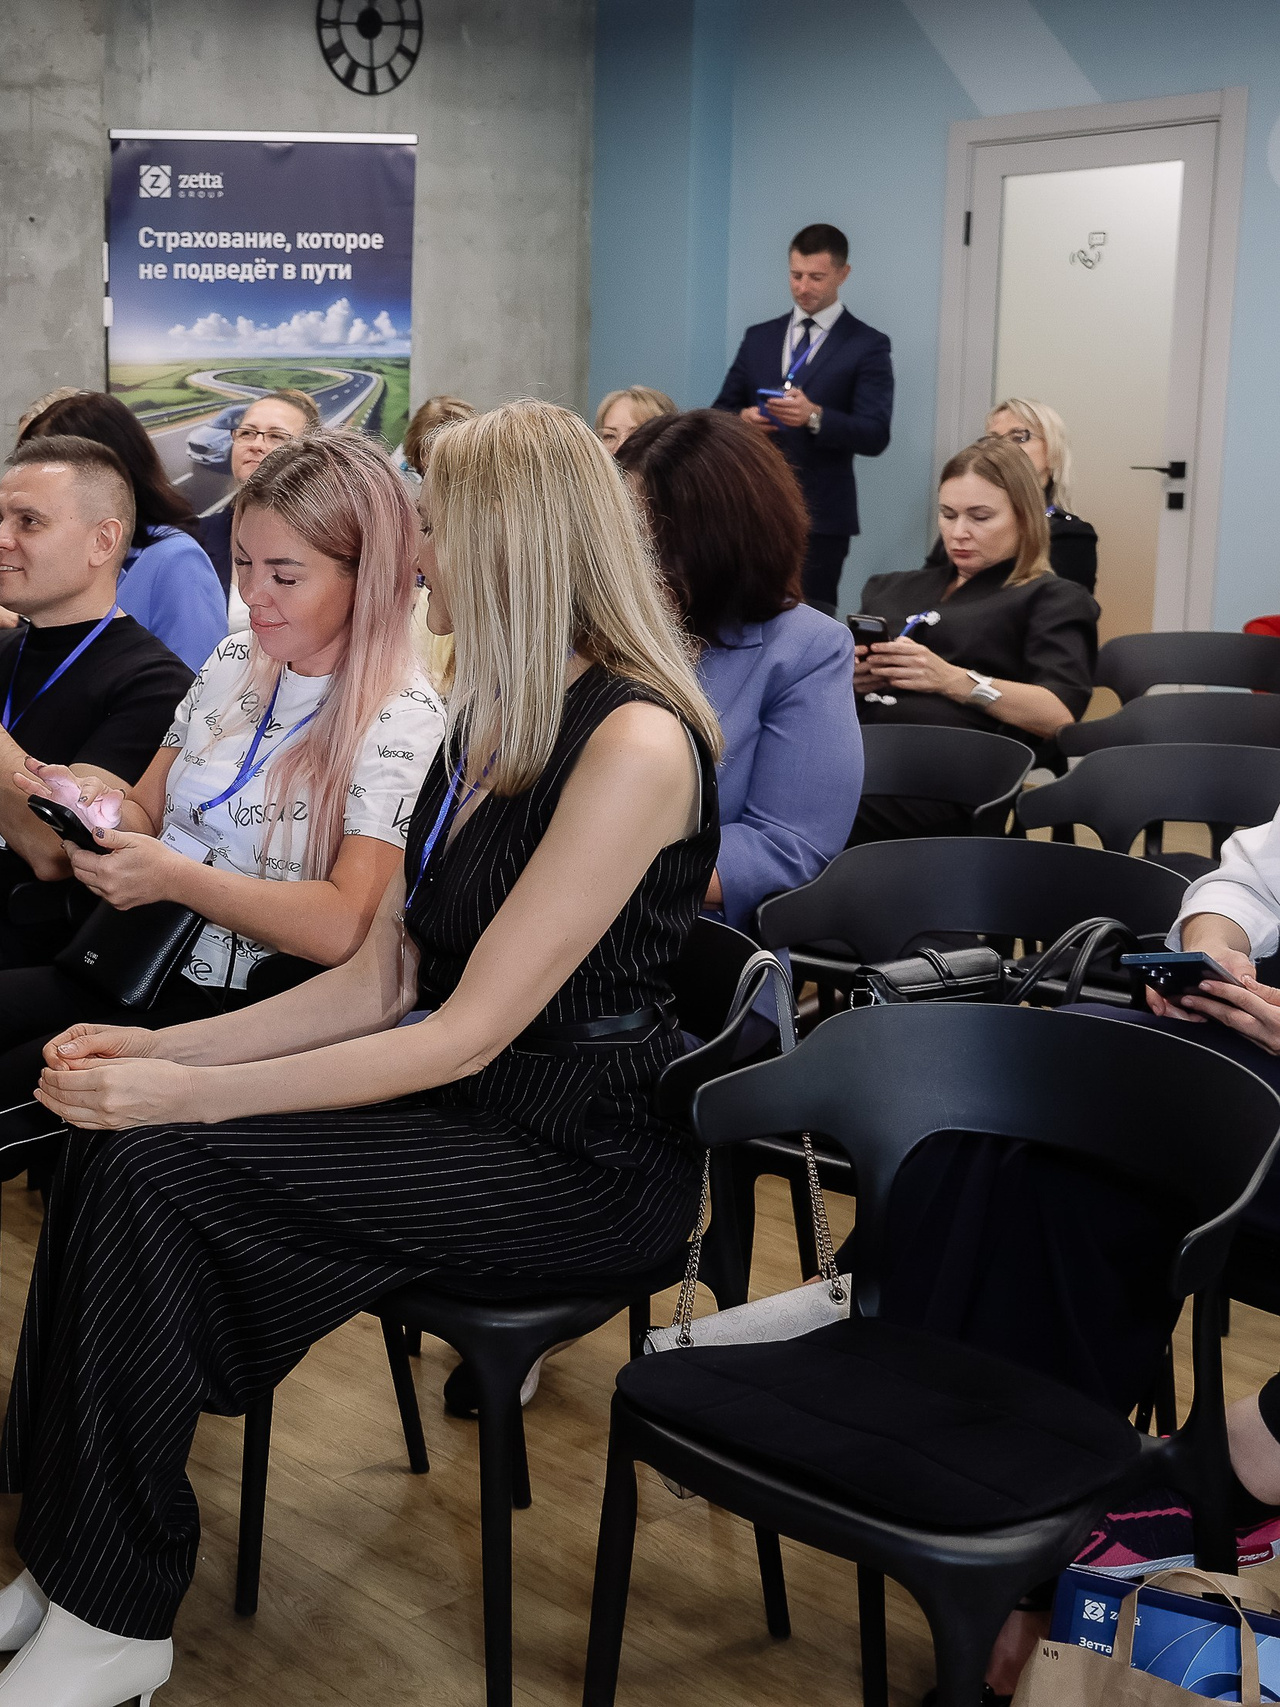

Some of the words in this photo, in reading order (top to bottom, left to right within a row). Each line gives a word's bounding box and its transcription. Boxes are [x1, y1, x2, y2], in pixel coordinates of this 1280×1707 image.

[178, 172, 224, 189] zetta
[178, 190, 224, 199] GROUP
[138, 226, 292, 253] Страхование,
[296, 231, 384, 254] которое
[138, 262, 168, 280] не
[172, 257, 279, 283] подведёт
[282, 263, 297, 280] в
[300, 262, 353, 285] пути
[376, 744, 415, 761] Versace
[1079, 1637, 1112, 1653] Зетта
